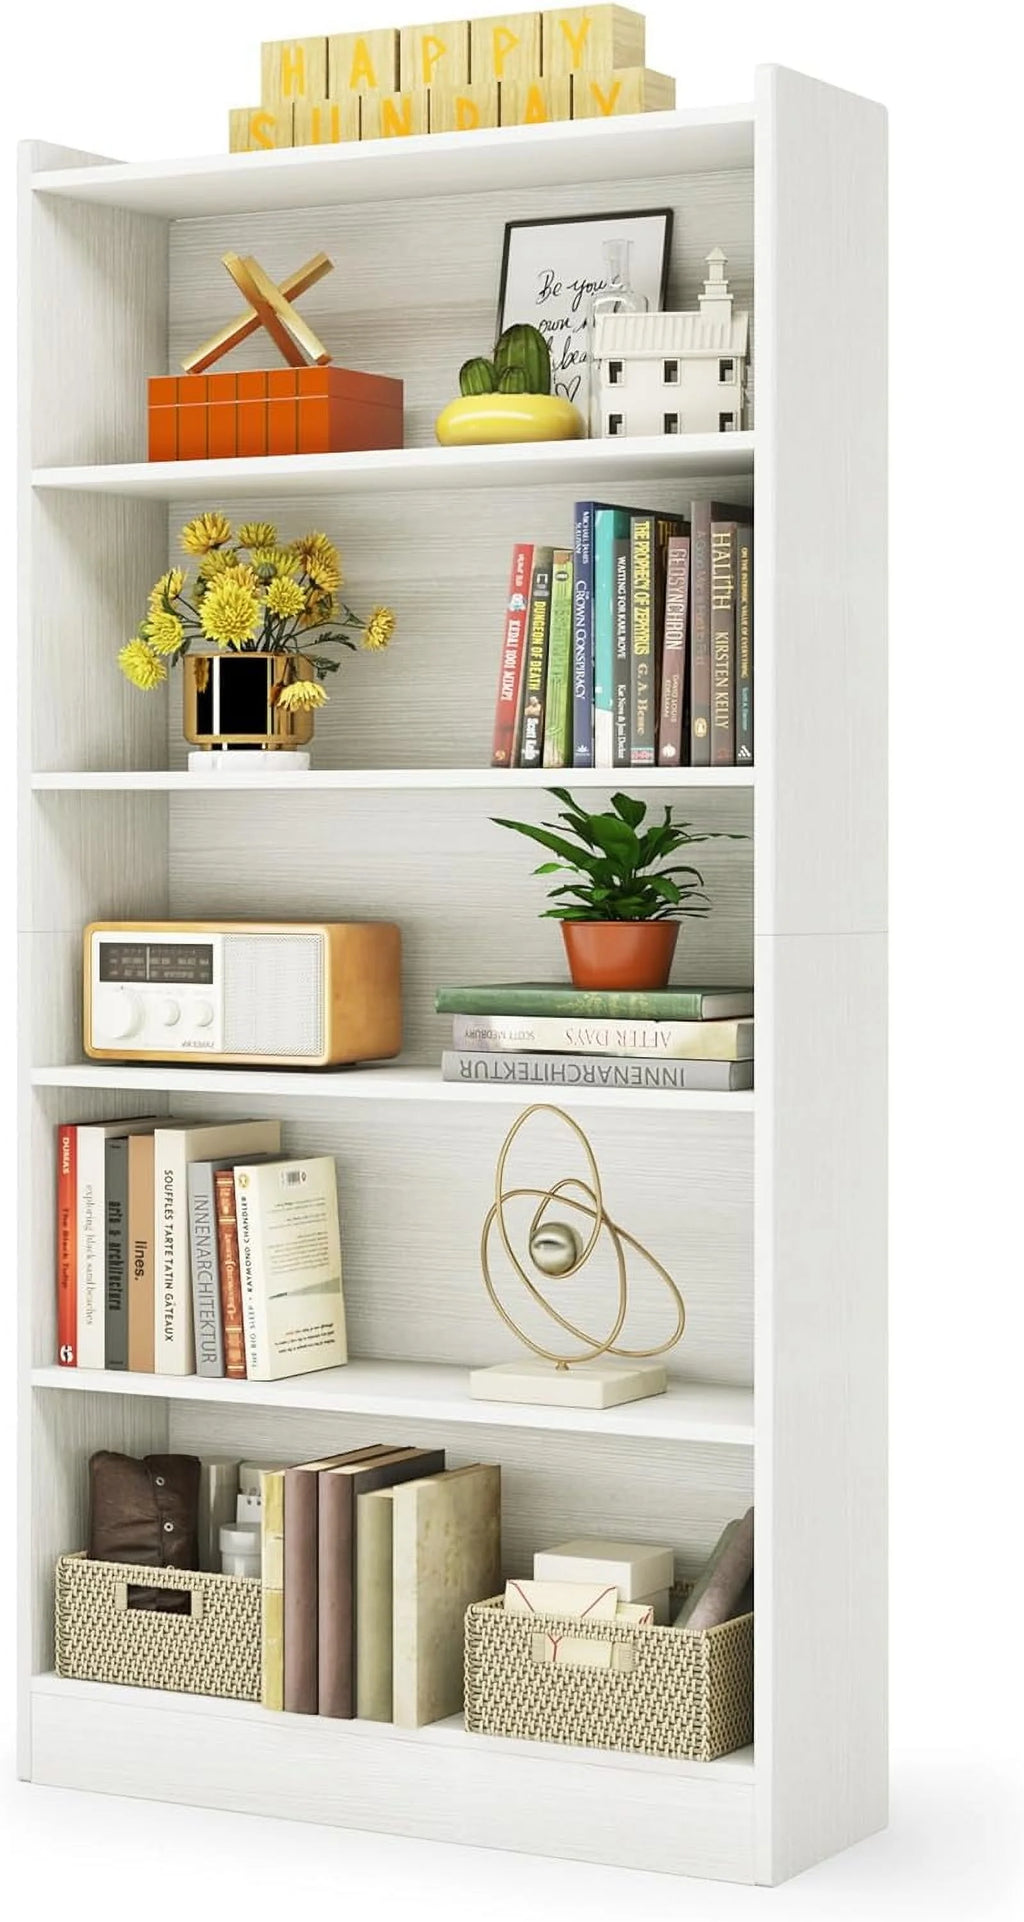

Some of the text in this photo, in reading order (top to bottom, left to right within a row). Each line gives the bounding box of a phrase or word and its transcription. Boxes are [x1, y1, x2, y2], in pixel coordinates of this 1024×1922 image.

[284, 18, 591, 97] HAPPY
[245, 80, 622, 151] SUNDAY
[536, 269, 562, 305] Be
[539, 318, 572, 334] own
[617, 556, 626, 594] WAITING
[634, 520, 651, 656] THE PROPHECY OF ZEPHYRUS
[712, 532, 734, 610] HALITH
[617, 595, 626, 613] FOR
[666, 548, 687, 651] GEOSYNCHRON
[528, 600, 547, 691] DUNGEON OF DEATH
[575, 580, 587, 700] CROWN CONSPIRACY
[617, 614, 626, 636] KARL
[637, 663, 648, 679] G.
[637, 681, 648, 696] A.
[714, 631, 729, 729] KIRSTEN KELLY
[565, 1027, 672, 1048] AFTER DAYS
[460, 1059, 684, 1088] INNENARCHITEKTUR
[62, 1137, 70, 1175] DUMAS
[164, 1224, 174, 1256] TARTE
[241, 1196, 251, 1246] CHANDLER
[82, 1184, 96, 1325] exploring black sand beaches
[134, 1240, 148, 1281] lines.
[164, 1259, 174, 1290] TATIN
[244, 1247, 253, 1293] RAYMOND
[194, 1194, 217, 1363] INNENARCHITEKTUR
